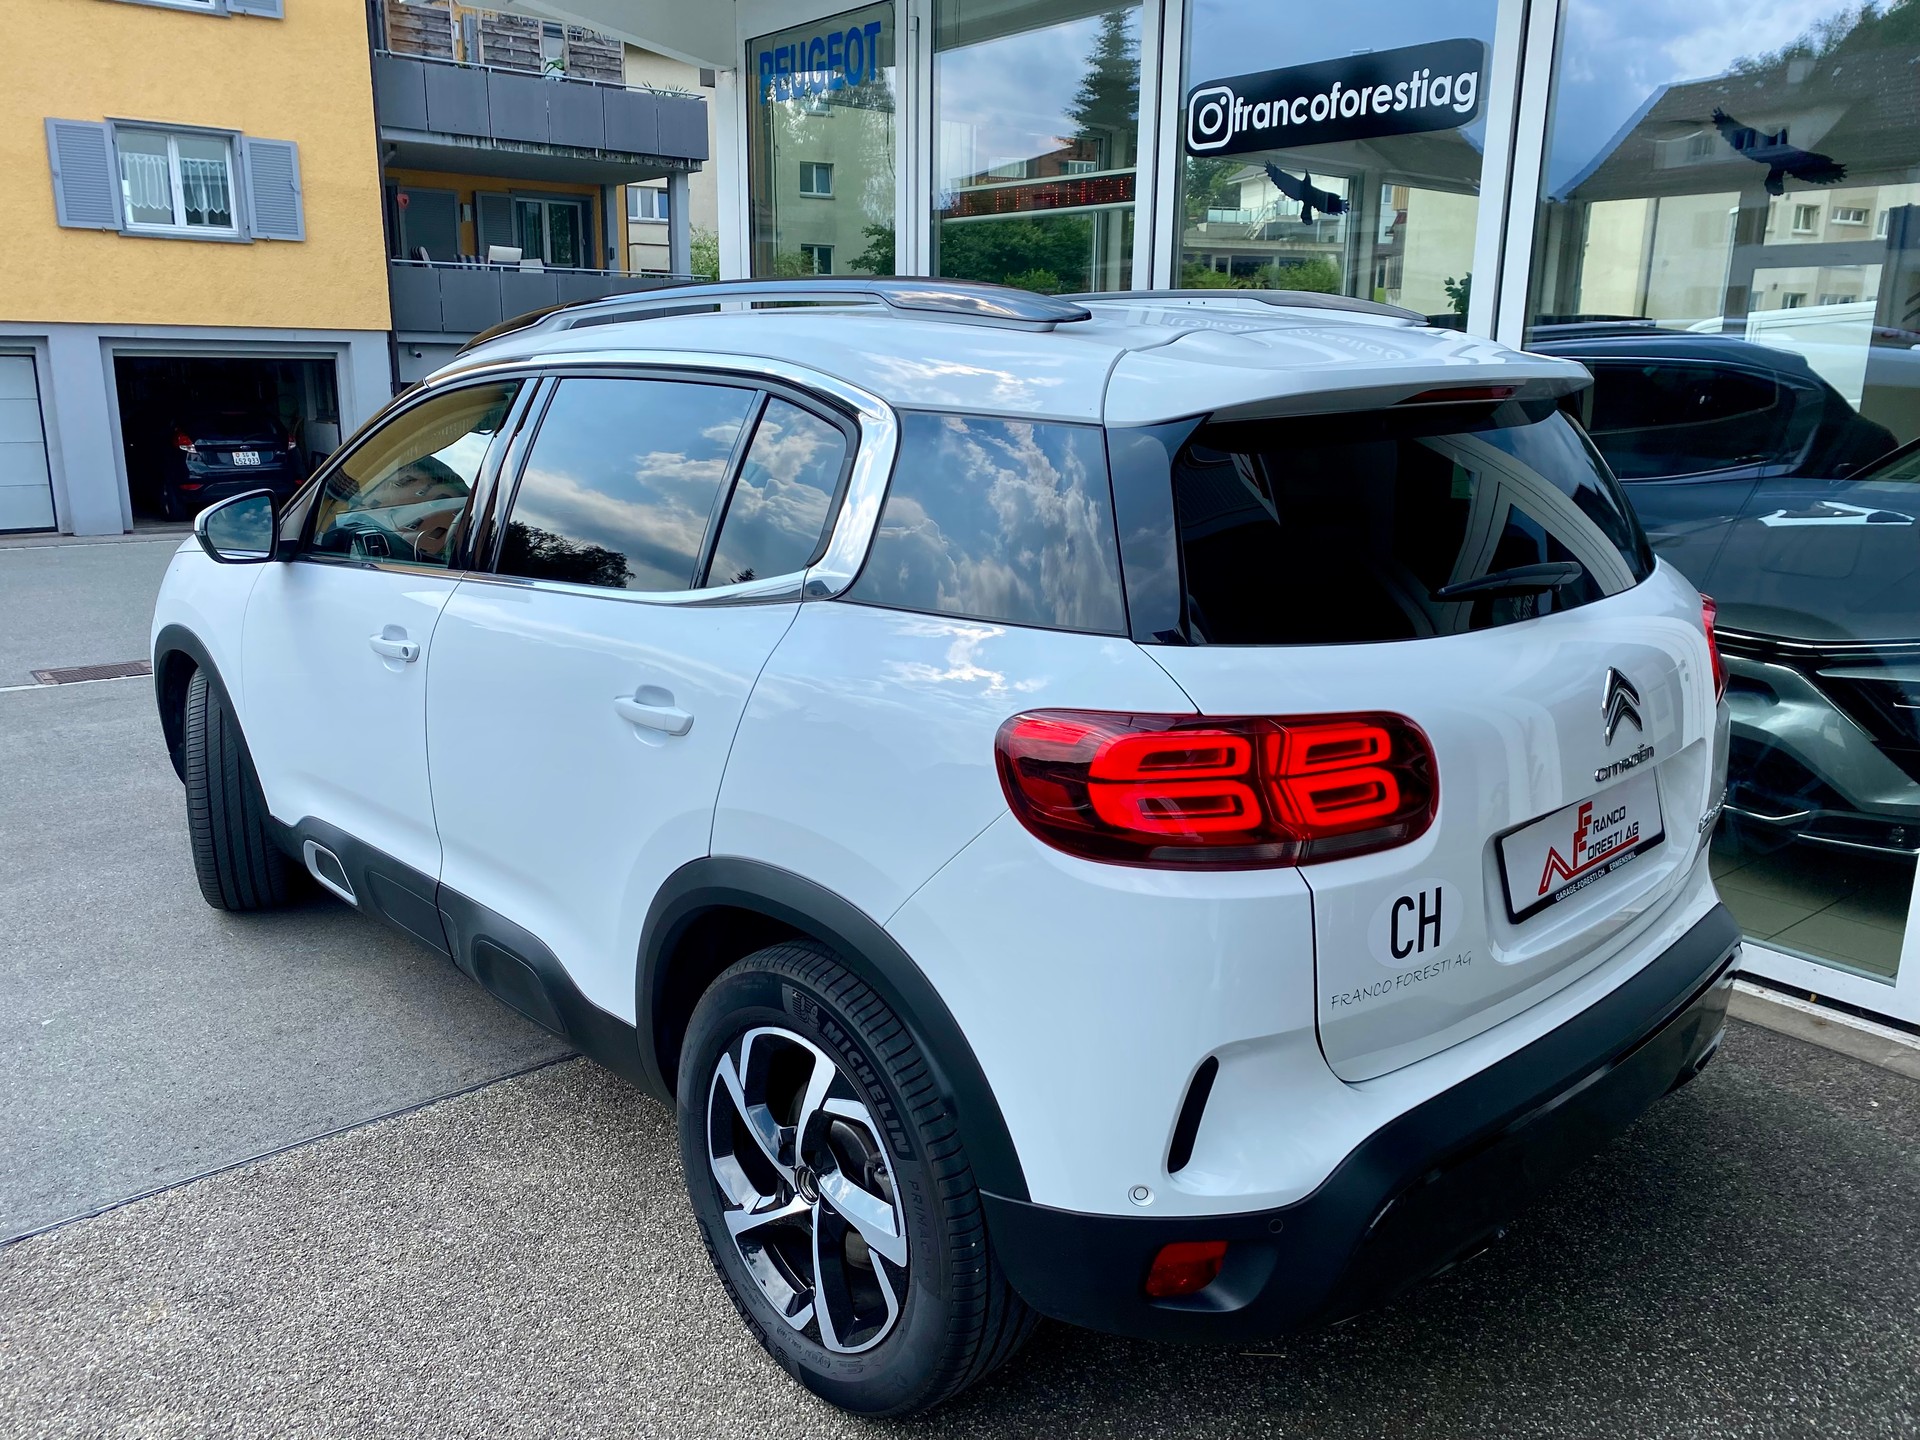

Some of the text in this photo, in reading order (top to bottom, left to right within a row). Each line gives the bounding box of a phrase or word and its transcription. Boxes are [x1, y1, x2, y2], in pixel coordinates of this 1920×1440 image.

[759, 20, 882, 106] PEUGEOT
[1234, 67, 1478, 133] francoforestiag
[1555, 868, 1606, 902] GARAGE-FORESTI.CH
[1390, 886, 1442, 960] CH
[1331, 950, 1472, 1011] FRANCO FORESTI AG
[822, 1020, 911, 1154] MICHELIN
